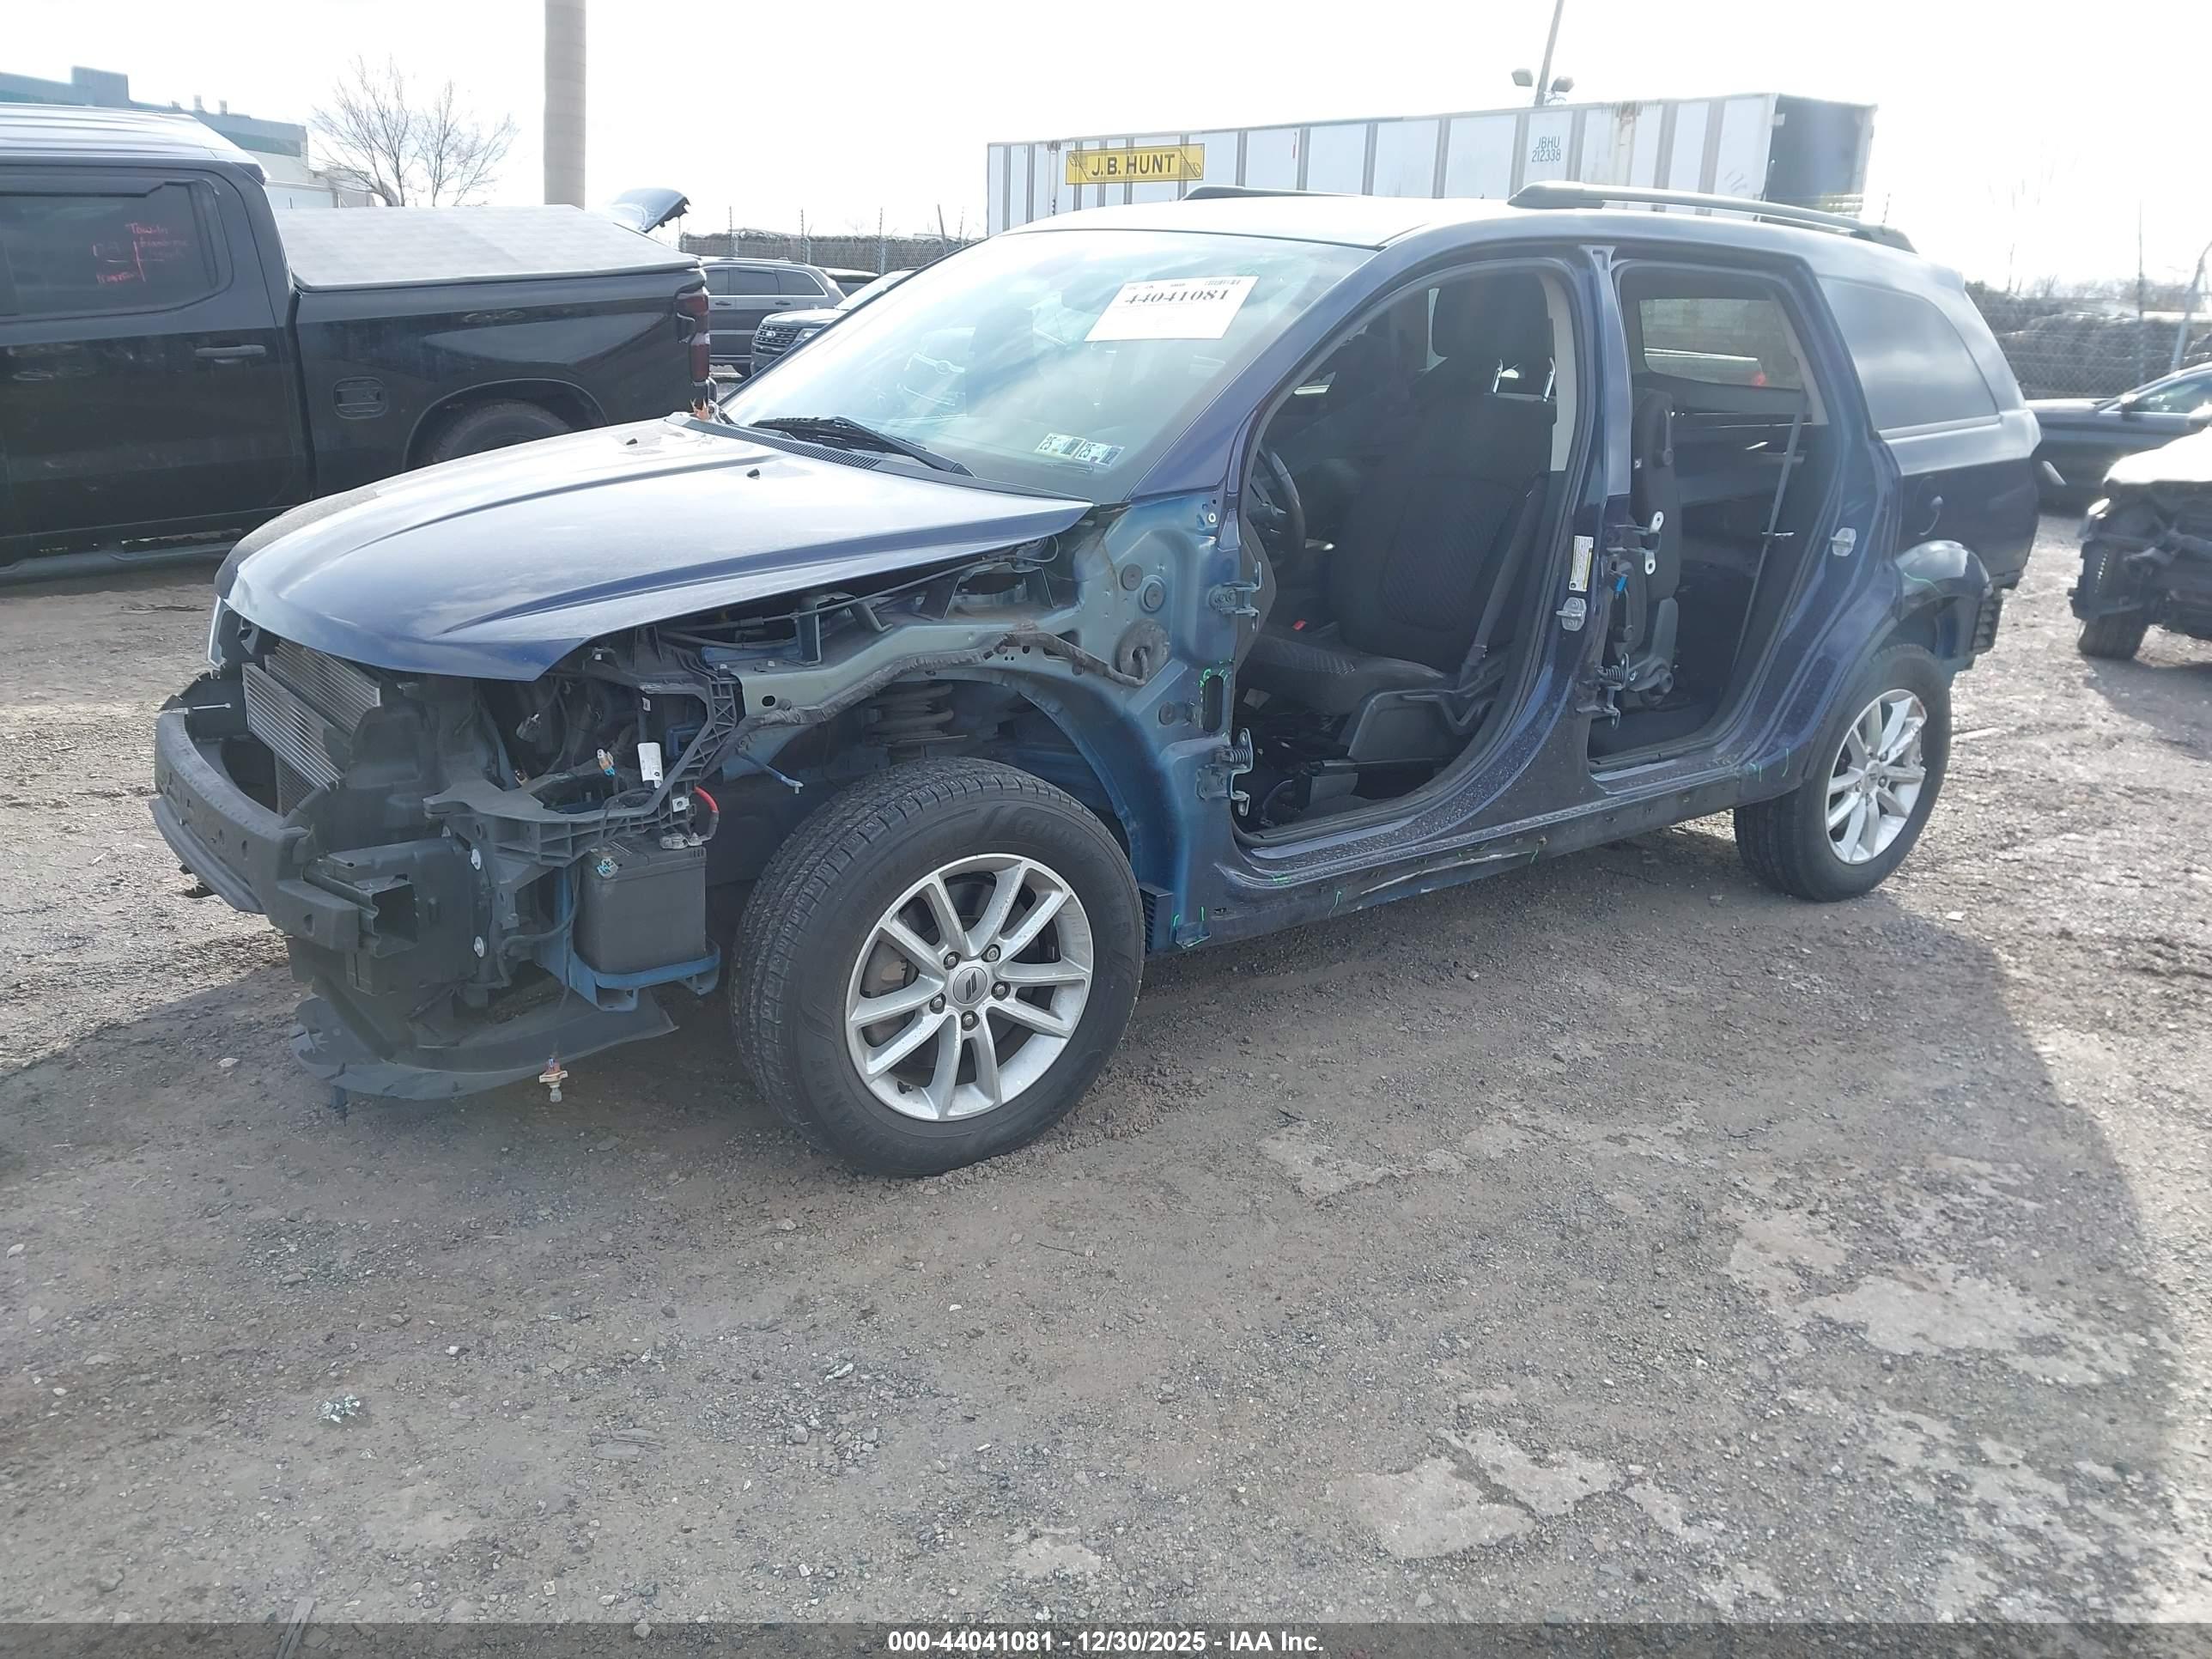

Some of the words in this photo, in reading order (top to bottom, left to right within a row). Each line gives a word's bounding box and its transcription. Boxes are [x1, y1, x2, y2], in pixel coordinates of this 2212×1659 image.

[1535, 136, 1560, 149] JBHU
[1531, 148, 1562, 162] 212338
[1091, 156, 1121, 176] J.B.
[1127, 155, 1176, 175] HUNT
[1125, 289, 1230, 305] 44041081
